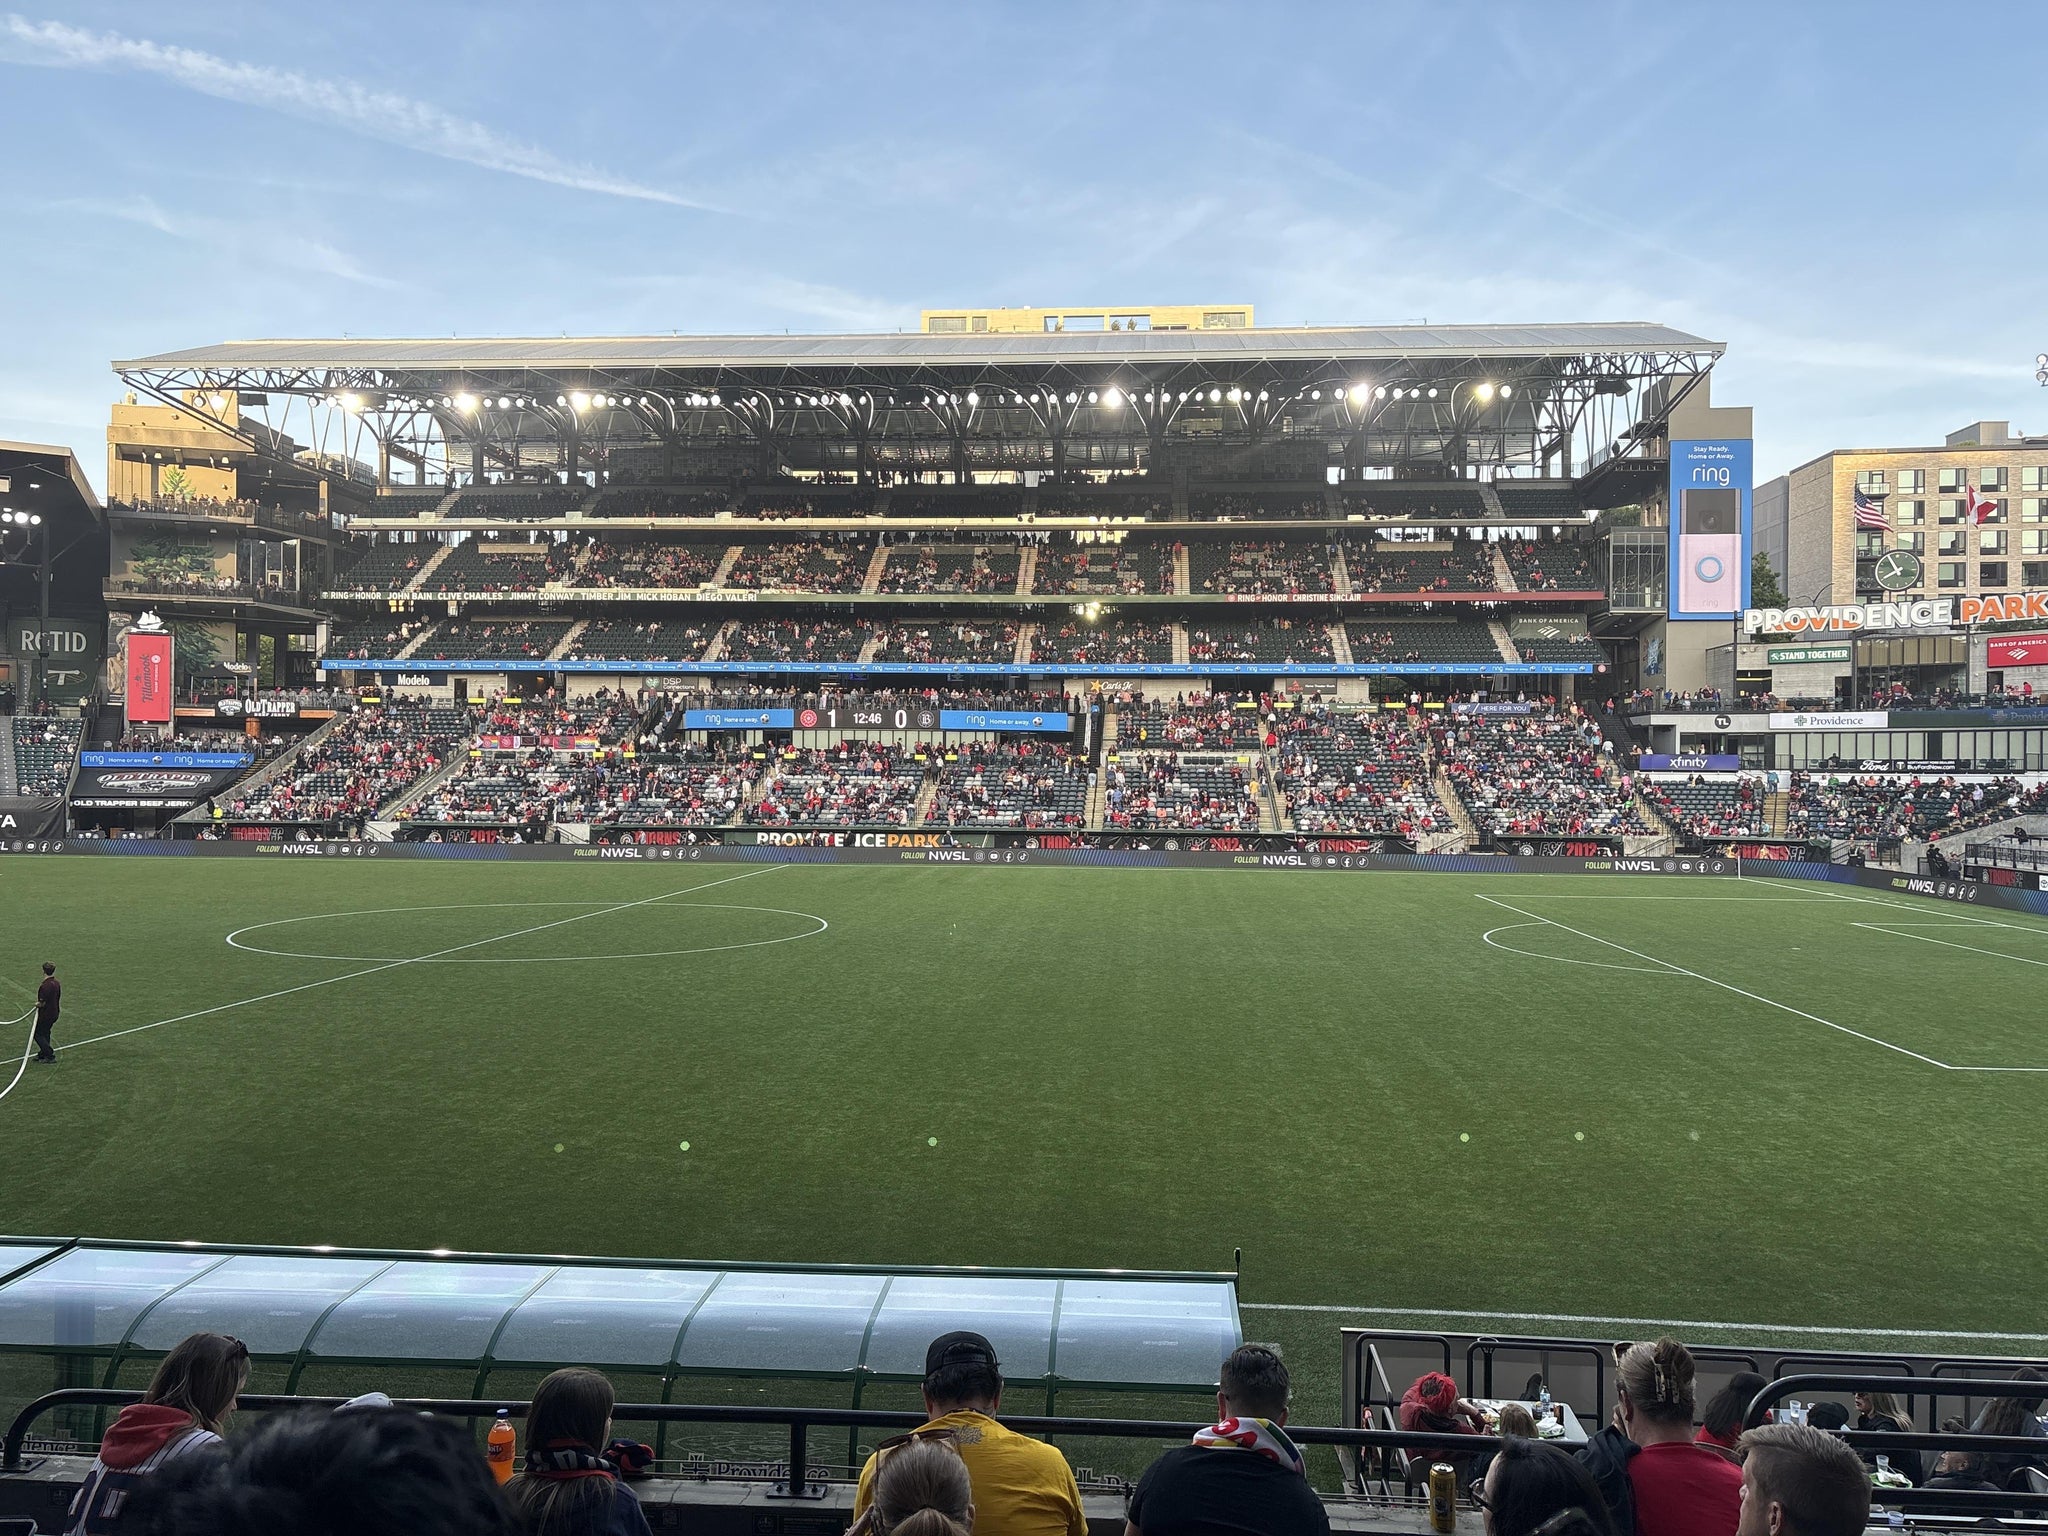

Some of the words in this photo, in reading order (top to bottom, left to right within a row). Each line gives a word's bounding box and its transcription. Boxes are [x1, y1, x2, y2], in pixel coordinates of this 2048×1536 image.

[1692, 464, 1730, 486] ring
[387, 592, 410, 600] JOHN
[412, 592, 432, 600] BAIN
[438, 592, 462, 600] CLIVE
[463, 592, 503, 600] CHARLES
[509, 592, 537, 600] JIMMY
[581, 592, 614, 601] TIMBER
[616, 593, 631, 601] JIM
[636, 593, 659, 601] MICK
[660, 593, 691, 601] HOBAN
[696, 593, 723, 601] DIEGO
[725, 593, 757, 601] VALERI
[1743, 598, 1952, 634] PROVIDENCE
[1960, 591, 2048, 625] PARK
[1780, 652, 1806, 660] STAND
[1807, 650, 1848, 659] TOGETHER
[140, 655, 153, 703] Tillamook
[398, 674, 430, 686] Modelo
[1101, 681, 1122, 690] Carl's
[261, 699, 295, 713] TRAPPER
[705, 713, 721, 725] ring
[827, 709, 836, 728] 1
[853, 713, 882, 724] 12:46
[895, 709, 907, 729] 0
[966, 714, 986, 726] ring
[1810, 716, 1864, 725] Providence
[85, 755, 104, 764] ring
[174, 755, 193, 765] ring
[1669, 756, 1708, 768] xfinity
[1860, 760, 1889, 771] Ford
[97, 774, 134, 783] OLD
[137, 772, 212, 783] TRAPPER
[757, 832, 886, 847] PROVECE
[887, 834, 940, 847] PARK
[256, 845, 280, 853] FOLLOW
[282, 844, 322, 854] NWSL
[573, 848, 598, 857] FOLLOW
[601, 848, 642, 858] NWSL
[901, 851, 926, 860] FOLLOW
[928, 850, 970, 861] NWSL
[1233, 855, 1260, 864] FOLLOW
[1262, 855, 1307, 866] NWSL
[1584, 861, 1612, 870] FOLLOW
[1615, 860, 1661, 871] NWSL
[1908, 878, 1935, 894] NWSL
[715, 1459, 830, 1478] Providece
